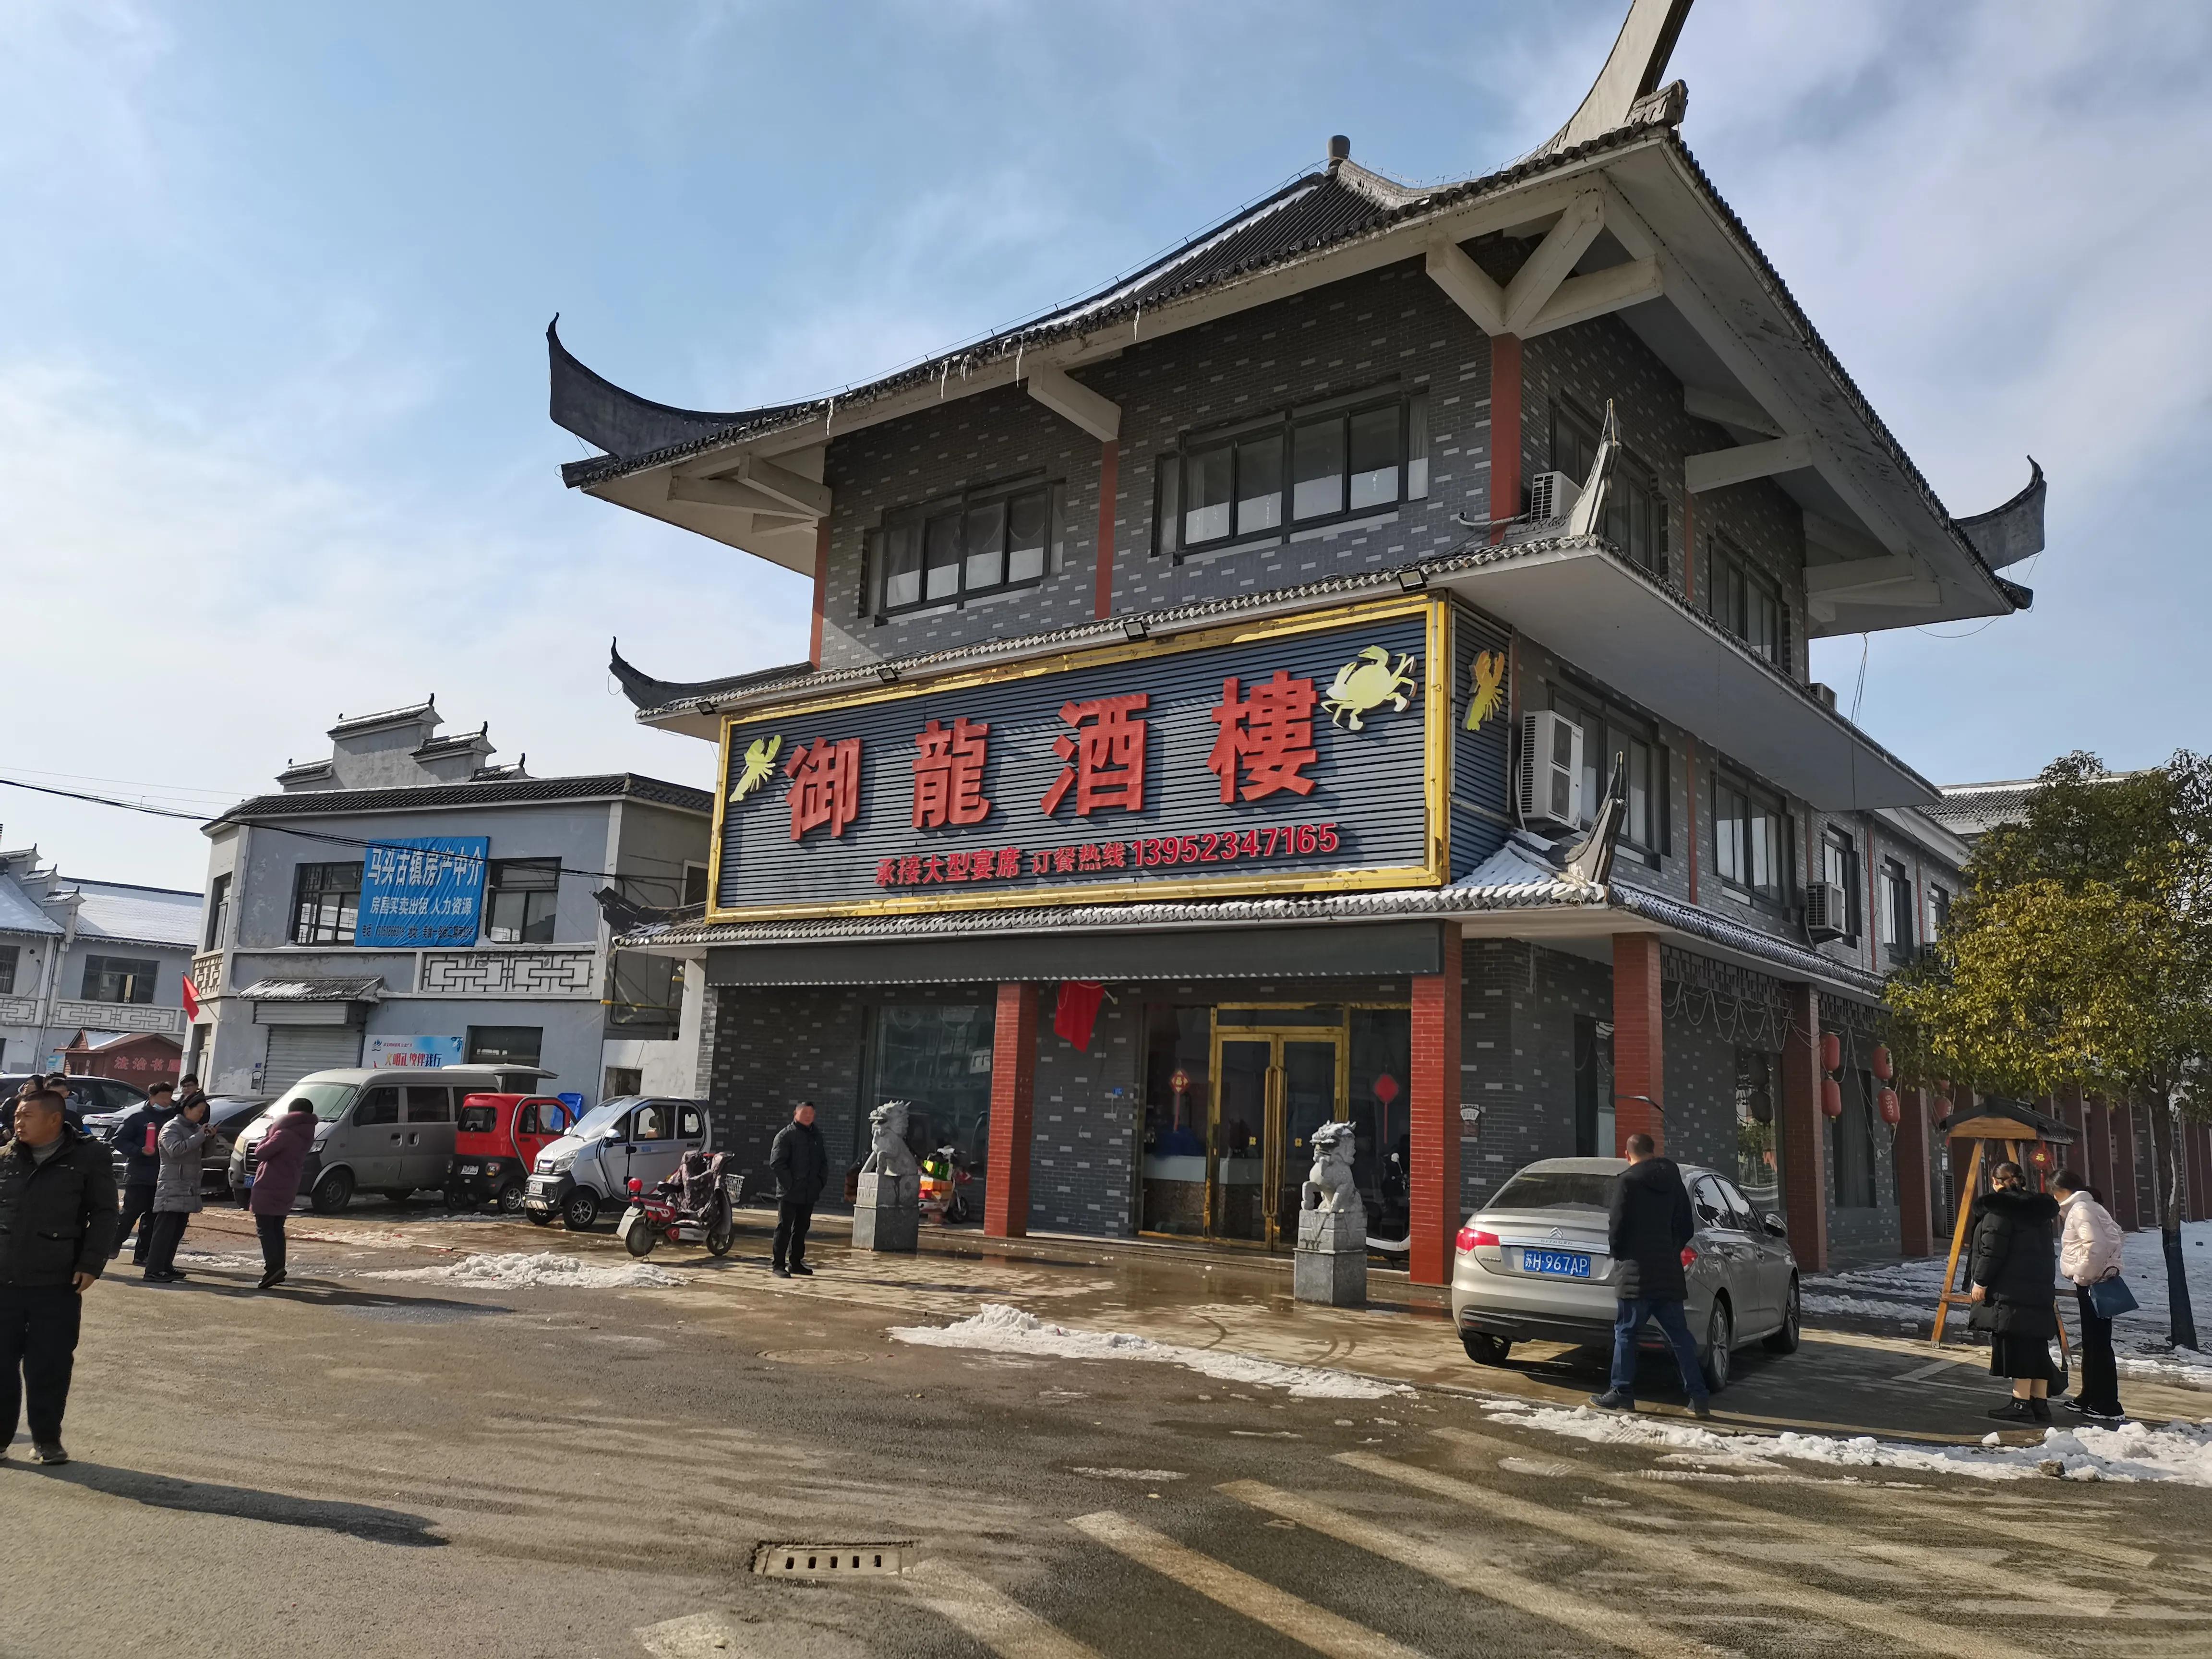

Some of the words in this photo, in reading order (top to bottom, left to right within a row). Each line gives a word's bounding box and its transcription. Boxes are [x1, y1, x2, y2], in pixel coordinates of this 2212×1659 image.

[783, 671, 1318, 840] 御龍酒樓
[368, 846, 483, 887] 马头古镇房产中介
[874, 846, 1021, 889] 承接大型宴席
[1031, 842, 1124, 875] 订餐热线
[1132, 822, 1339, 867] 13952347165
[370, 896, 428, 915] 房屋买卖出租
[431, 896, 473, 915] 人力资源
